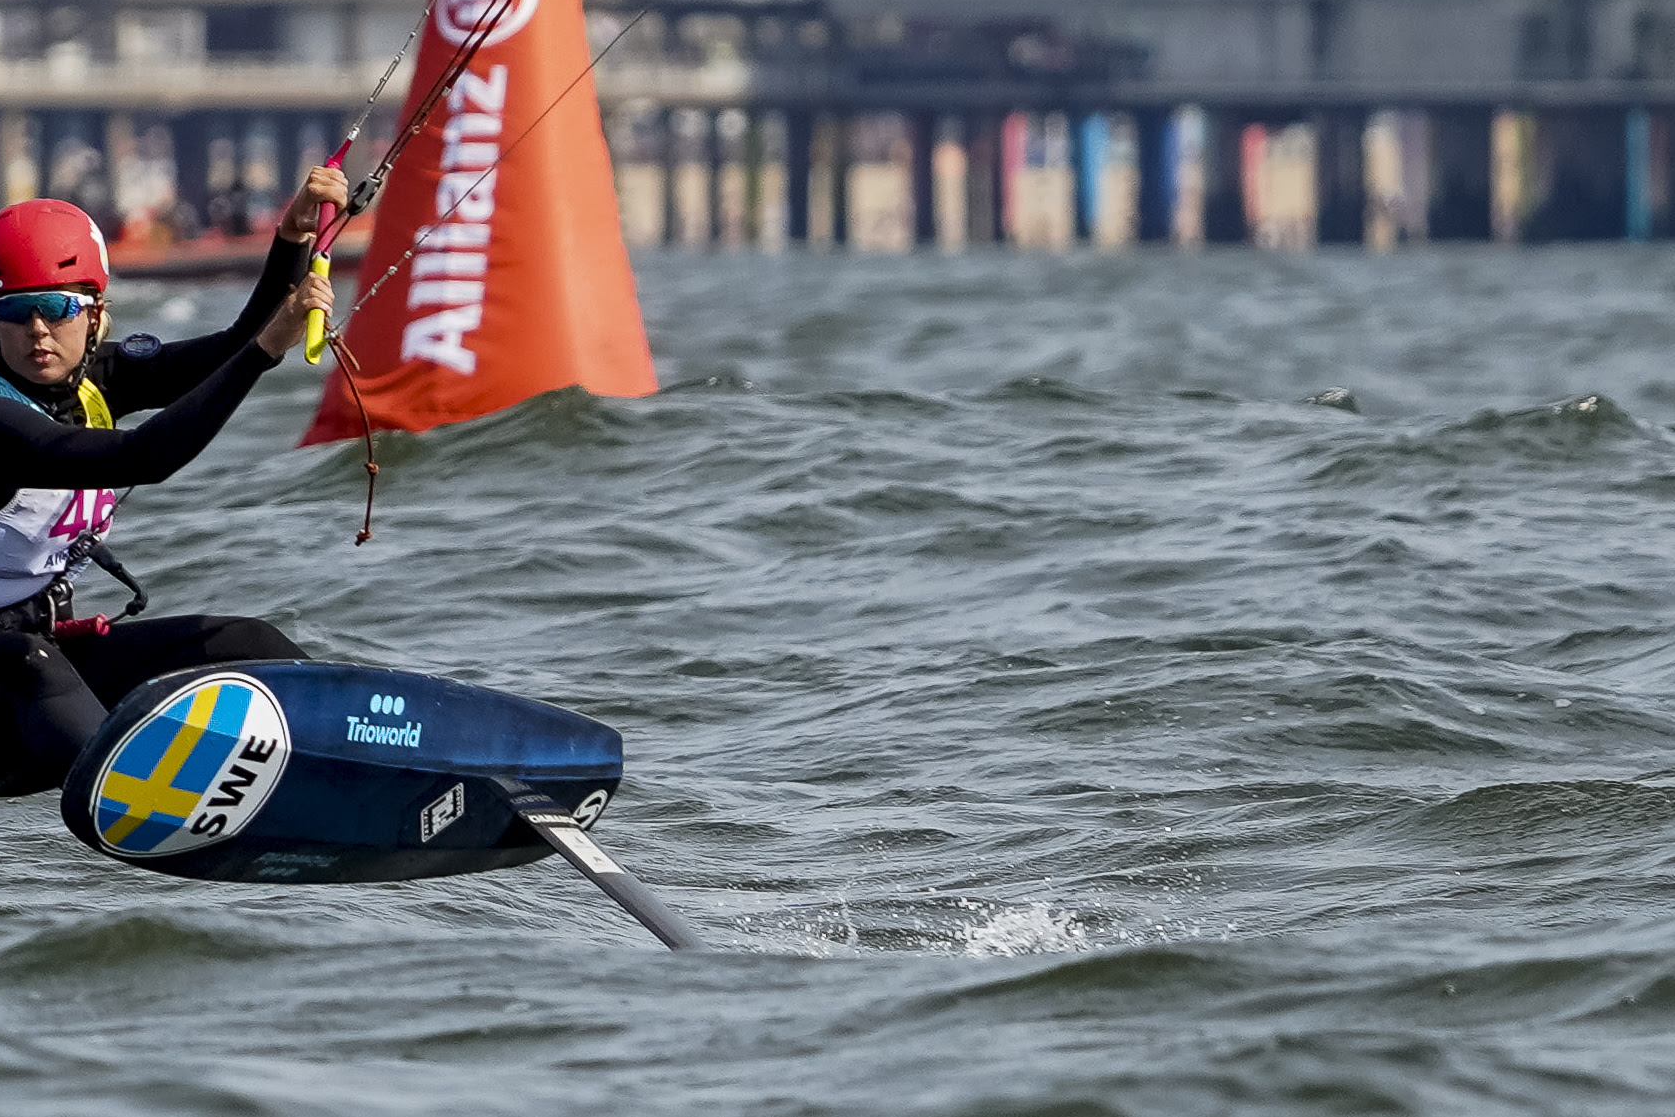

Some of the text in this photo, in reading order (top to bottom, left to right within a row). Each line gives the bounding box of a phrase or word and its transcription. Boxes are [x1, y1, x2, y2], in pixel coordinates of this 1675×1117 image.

[401, 63, 508, 375] Allianz
[346, 715, 422, 748] Trioworld
[189, 735, 278, 838] SWE
